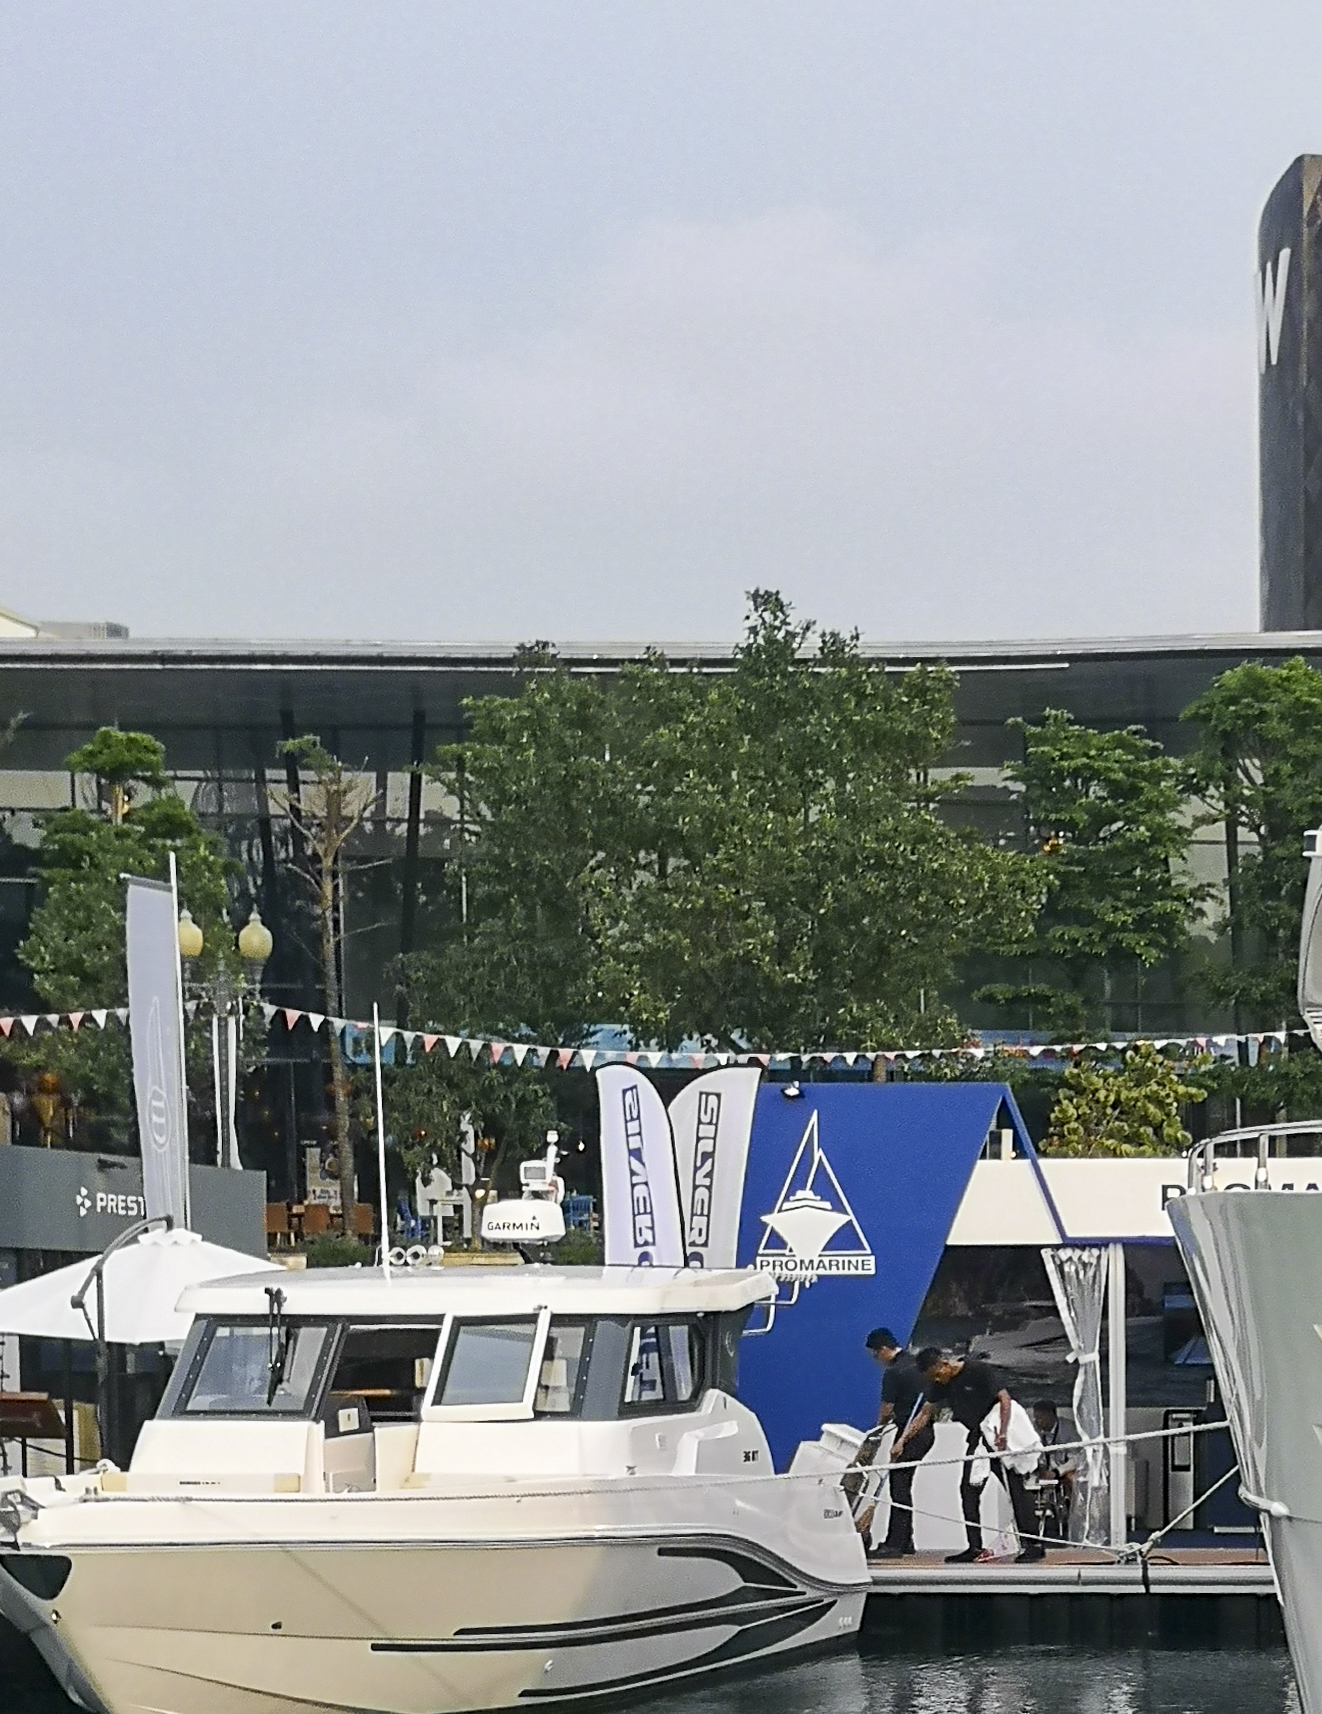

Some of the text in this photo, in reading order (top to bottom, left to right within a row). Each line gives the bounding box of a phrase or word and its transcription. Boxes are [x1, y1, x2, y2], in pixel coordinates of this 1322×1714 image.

[1253, 247, 1291, 374] W
[689, 1091, 720, 1247] SILVER
[96, 1192, 145, 1217] PREST
[487, 1221, 540, 1231] GARMIN
[760, 1259, 872, 1271] PROMARINE
